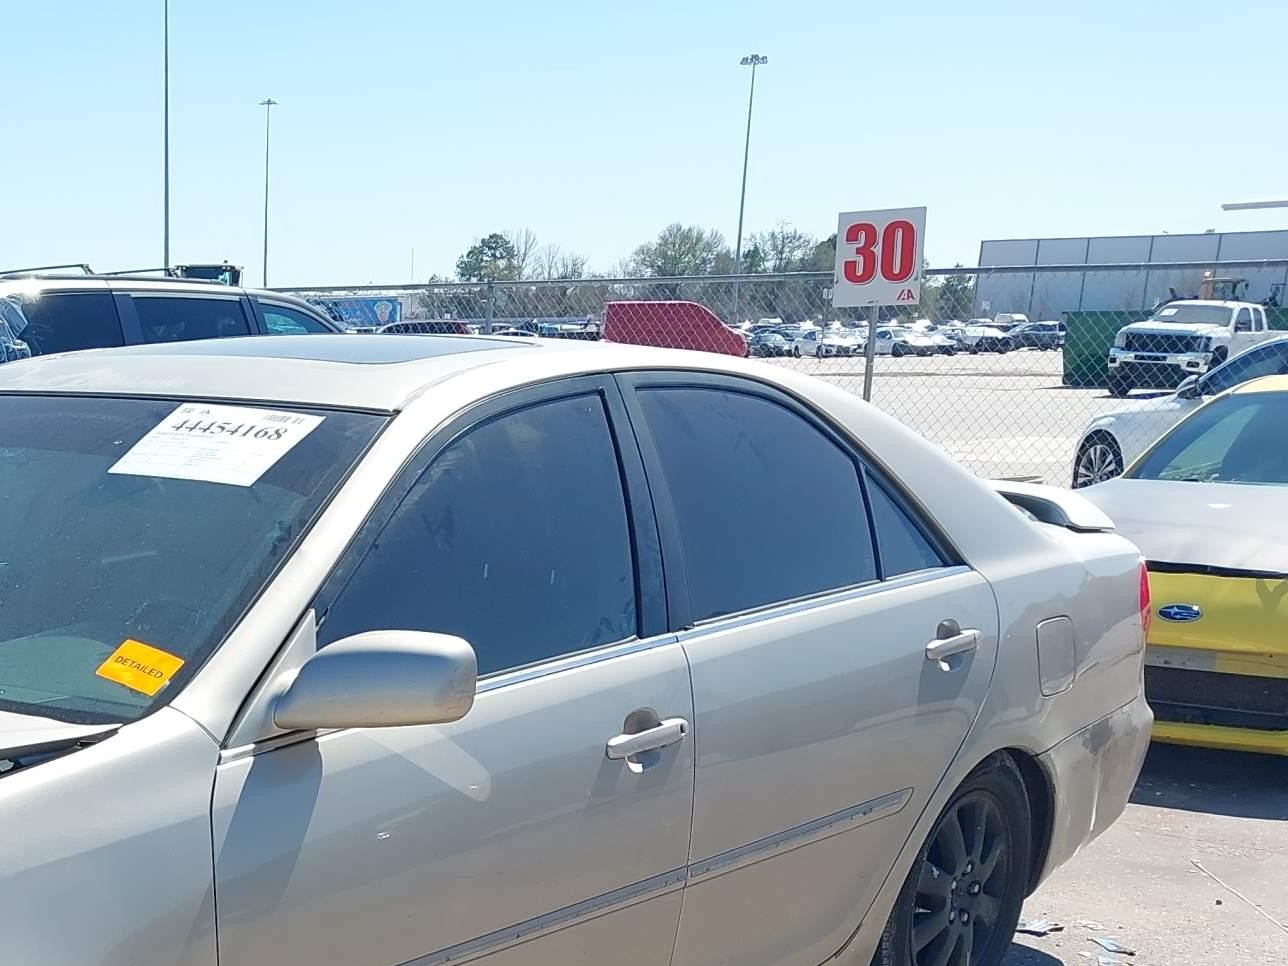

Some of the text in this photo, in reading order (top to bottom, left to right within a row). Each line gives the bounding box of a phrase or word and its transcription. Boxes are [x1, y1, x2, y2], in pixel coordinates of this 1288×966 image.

[843, 219, 917, 285] 30
[170, 418, 289, 441] 44454168
[114, 655, 165, 679] DETAILED
